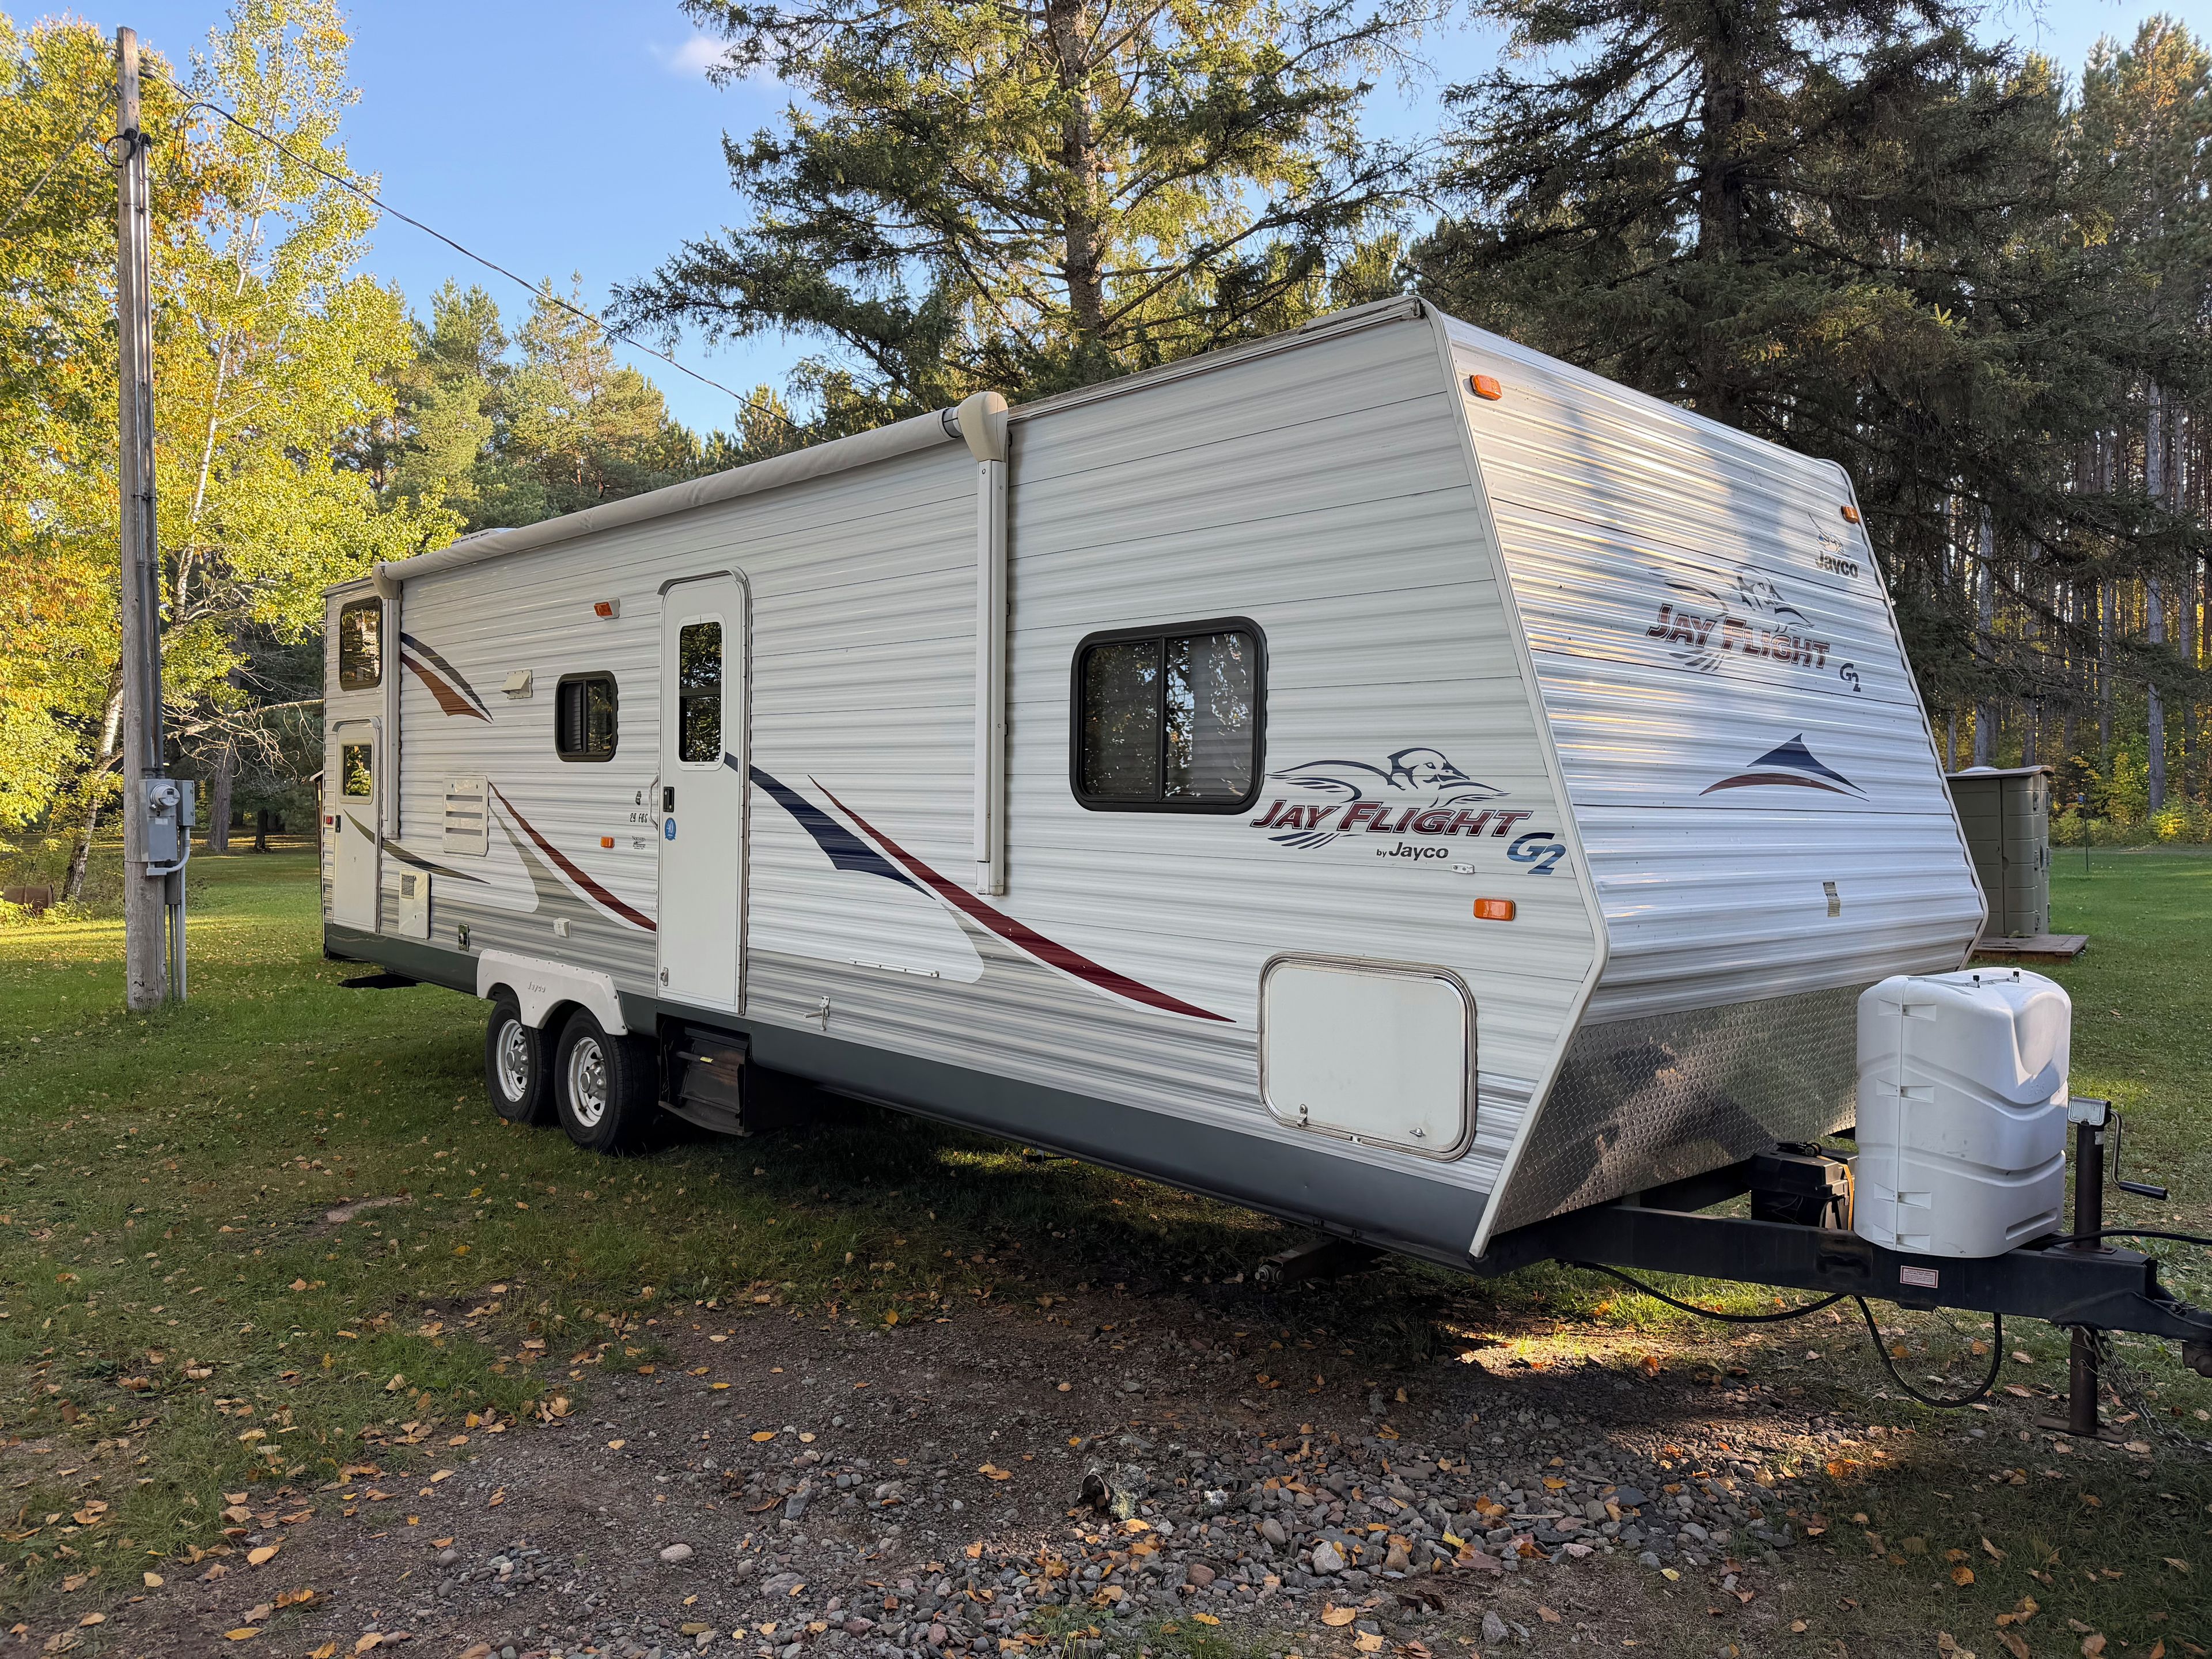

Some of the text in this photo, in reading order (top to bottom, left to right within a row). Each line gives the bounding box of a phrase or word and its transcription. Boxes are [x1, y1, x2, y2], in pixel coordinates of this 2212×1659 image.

[1815, 551, 1859, 578] Jayco
[1646, 603, 1831, 669] JAY FLIGHT
[1839, 662, 1861, 692] G2
[630, 813, 637, 823] 29
[1249, 799, 1534, 838] JAY FLIGHT
[1376, 842, 1449, 861] by Jayco
[1506, 832, 1566, 875] G2
